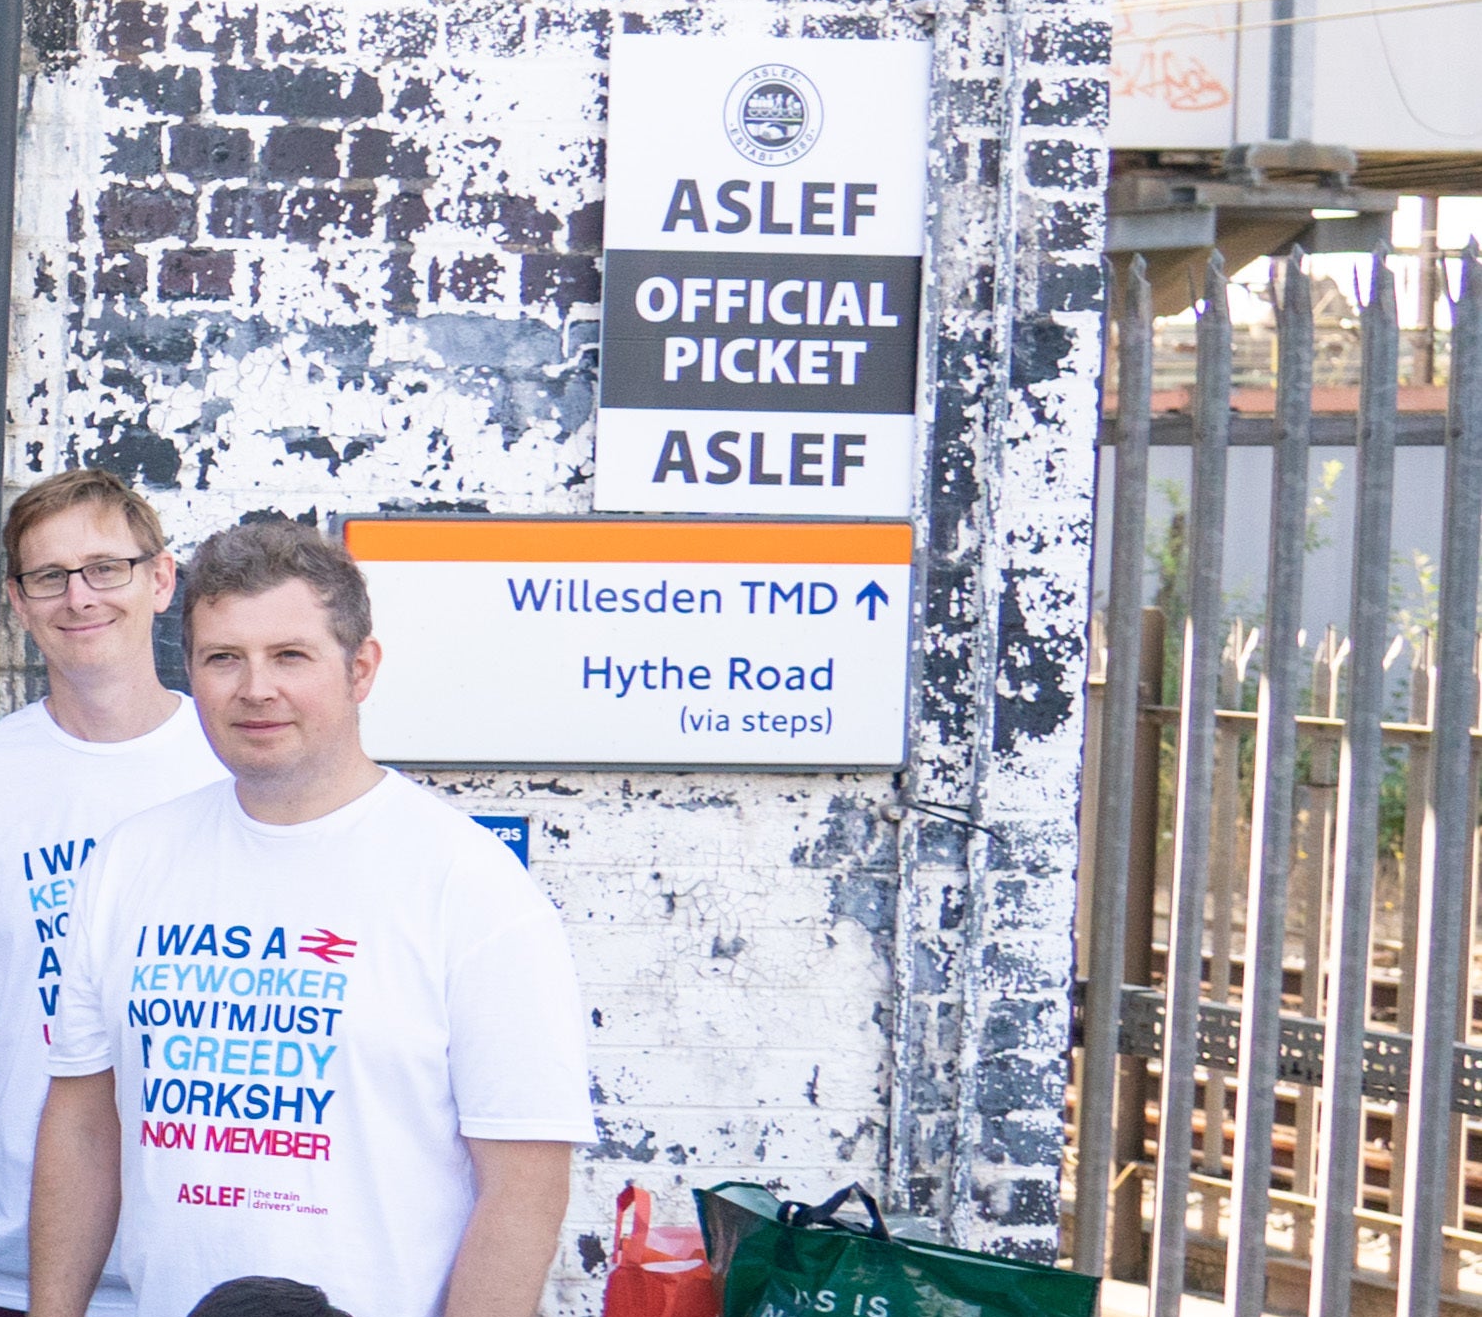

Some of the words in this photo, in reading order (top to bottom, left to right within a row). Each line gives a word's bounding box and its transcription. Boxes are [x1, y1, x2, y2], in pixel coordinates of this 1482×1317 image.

[662, 179, 877, 236] ASLEF
[636, 276, 898, 327] OFFICIAL
[664, 337, 867, 385] PICKET
[652, 430, 867, 486] ASLEF
[508, 578, 721, 613] Willesden
[741, 581, 838, 615] TMD
[583, 657, 711, 698] Hythe
[729, 657, 833, 690] Road
[681, 706, 729, 734] (via
[742, 707, 832, 737] steps)
[137, 926, 147, 957] I
[158, 924, 251, 959] WAS
[261, 927, 286, 959] A
[131, 964, 347, 1001] KEYWORKER
[129, 999, 206, 1028] NOW
[211, 1001, 255, 1032] I'M
[261, 1004, 342, 1036] JUST
[164, 1035, 338, 1080] GREEDY
[205, 1126, 331, 1161] MEMBER
[177, 1184, 245, 1207] ASLEF
[254, 1190, 272, 1200] the
[275, 1192, 300, 1201] train
[253, 1200, 294, 1211] drivers'
[297, 1205, 328, 1215] union
